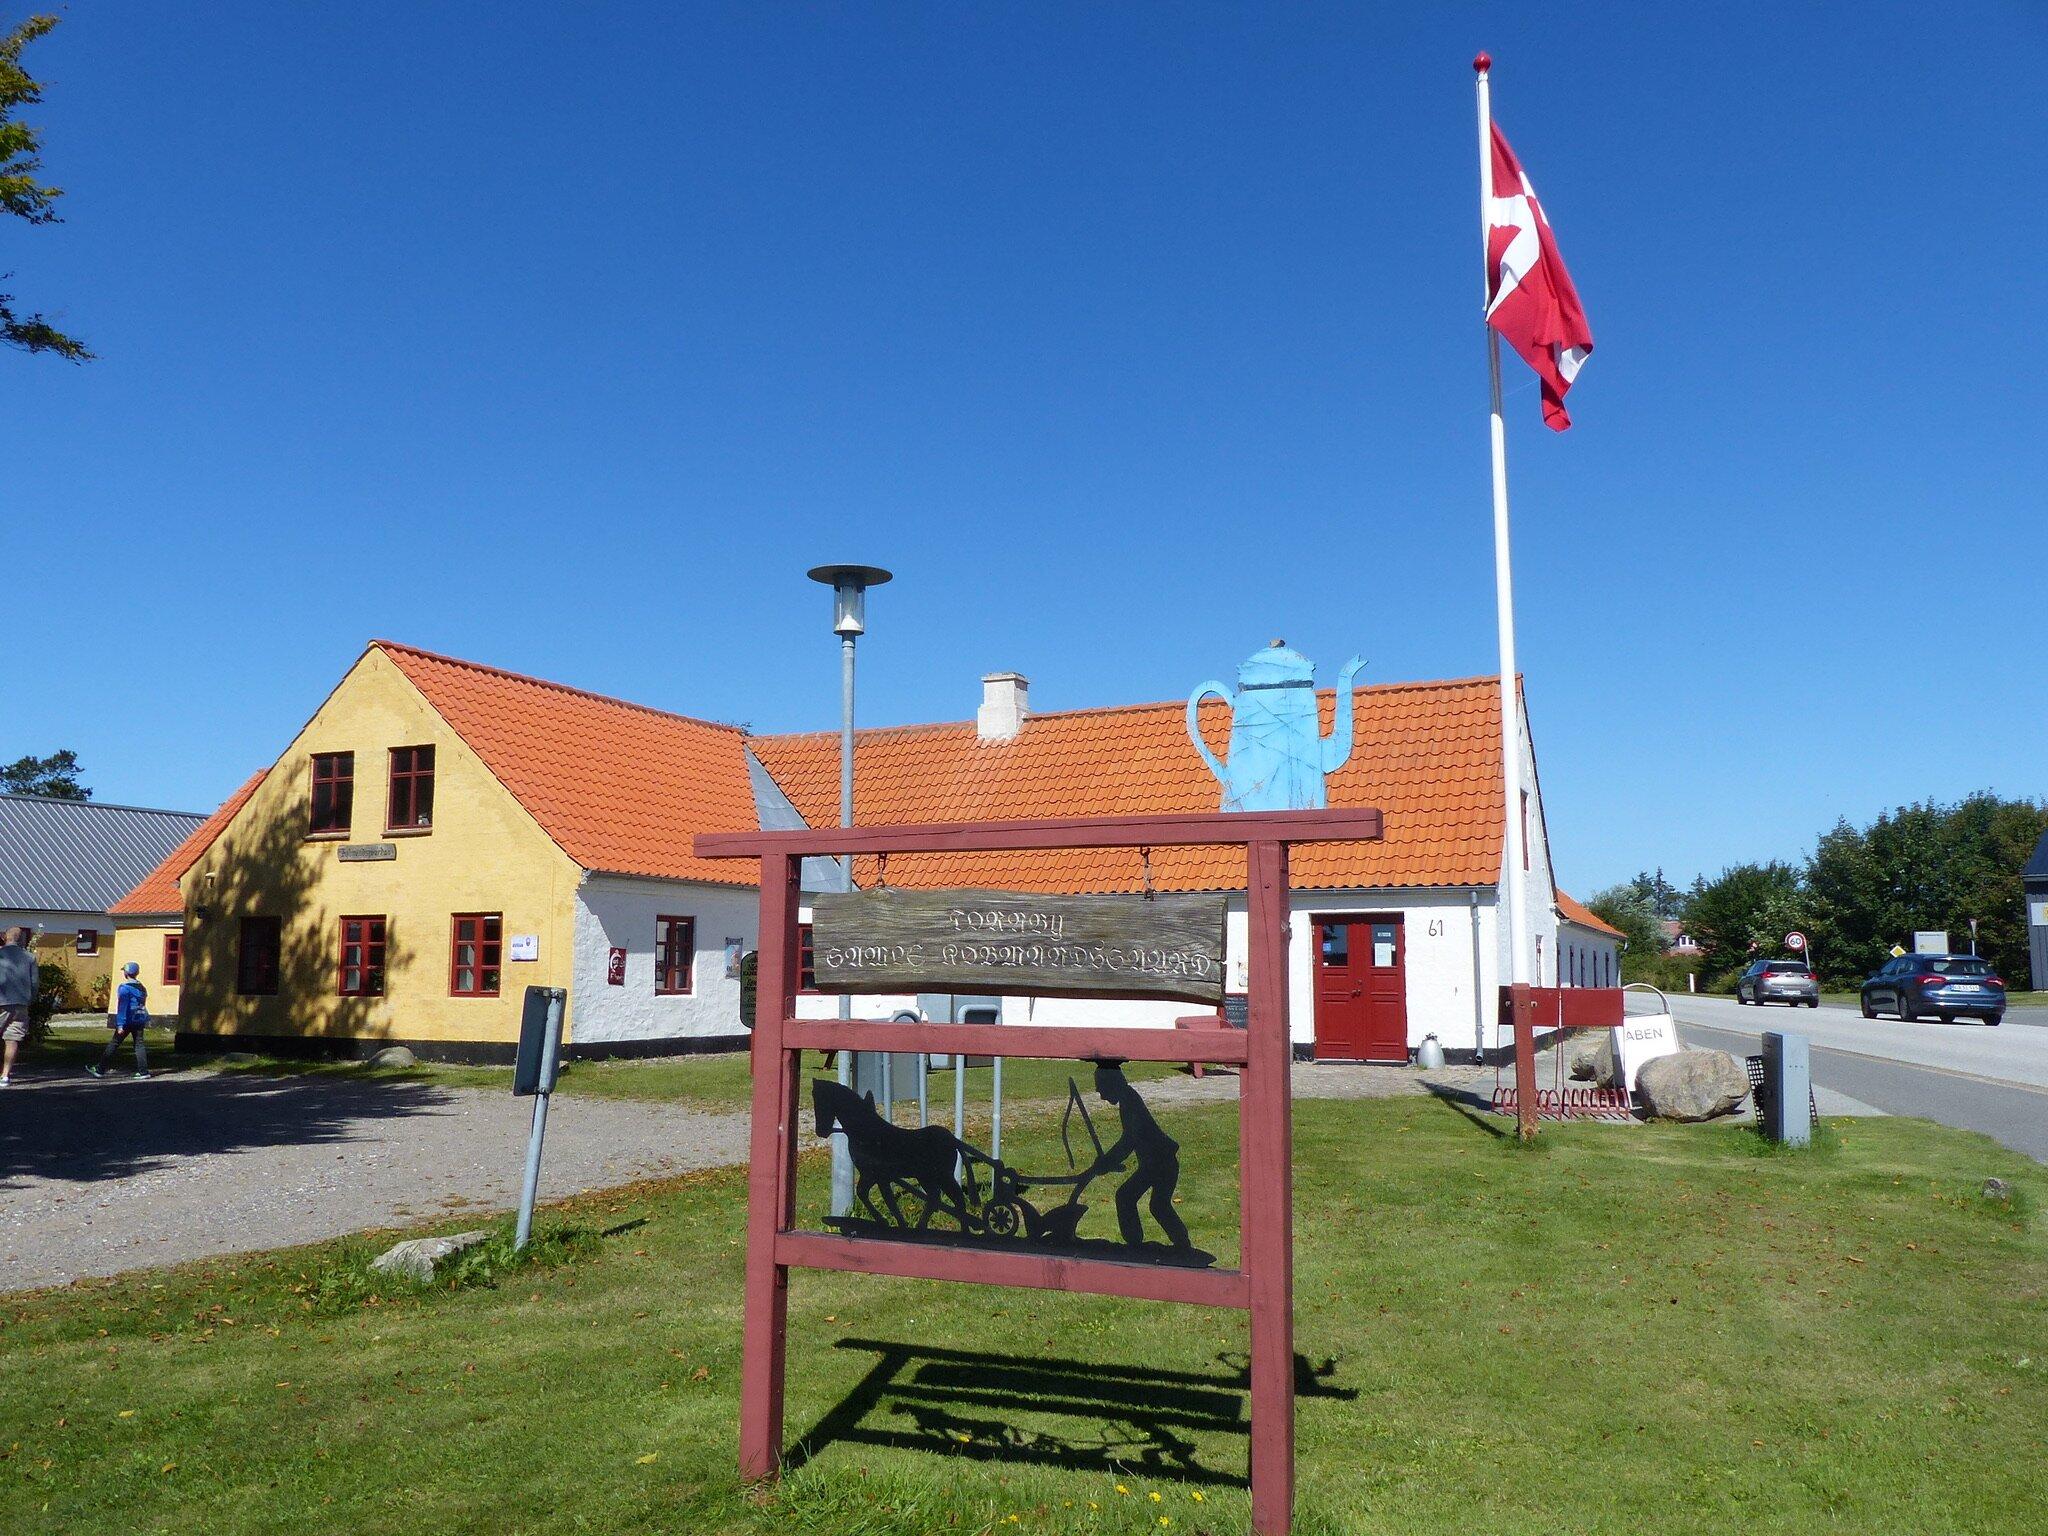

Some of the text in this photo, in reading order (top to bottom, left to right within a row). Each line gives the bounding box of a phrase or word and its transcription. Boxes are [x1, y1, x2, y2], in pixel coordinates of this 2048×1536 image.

[949, 909, 1064, 941] TORNBY
[1427, 919, 1444, 937] 61
[1789, 937, 1802, 946] 60
[826, 944, 926, 968] GAMLE
